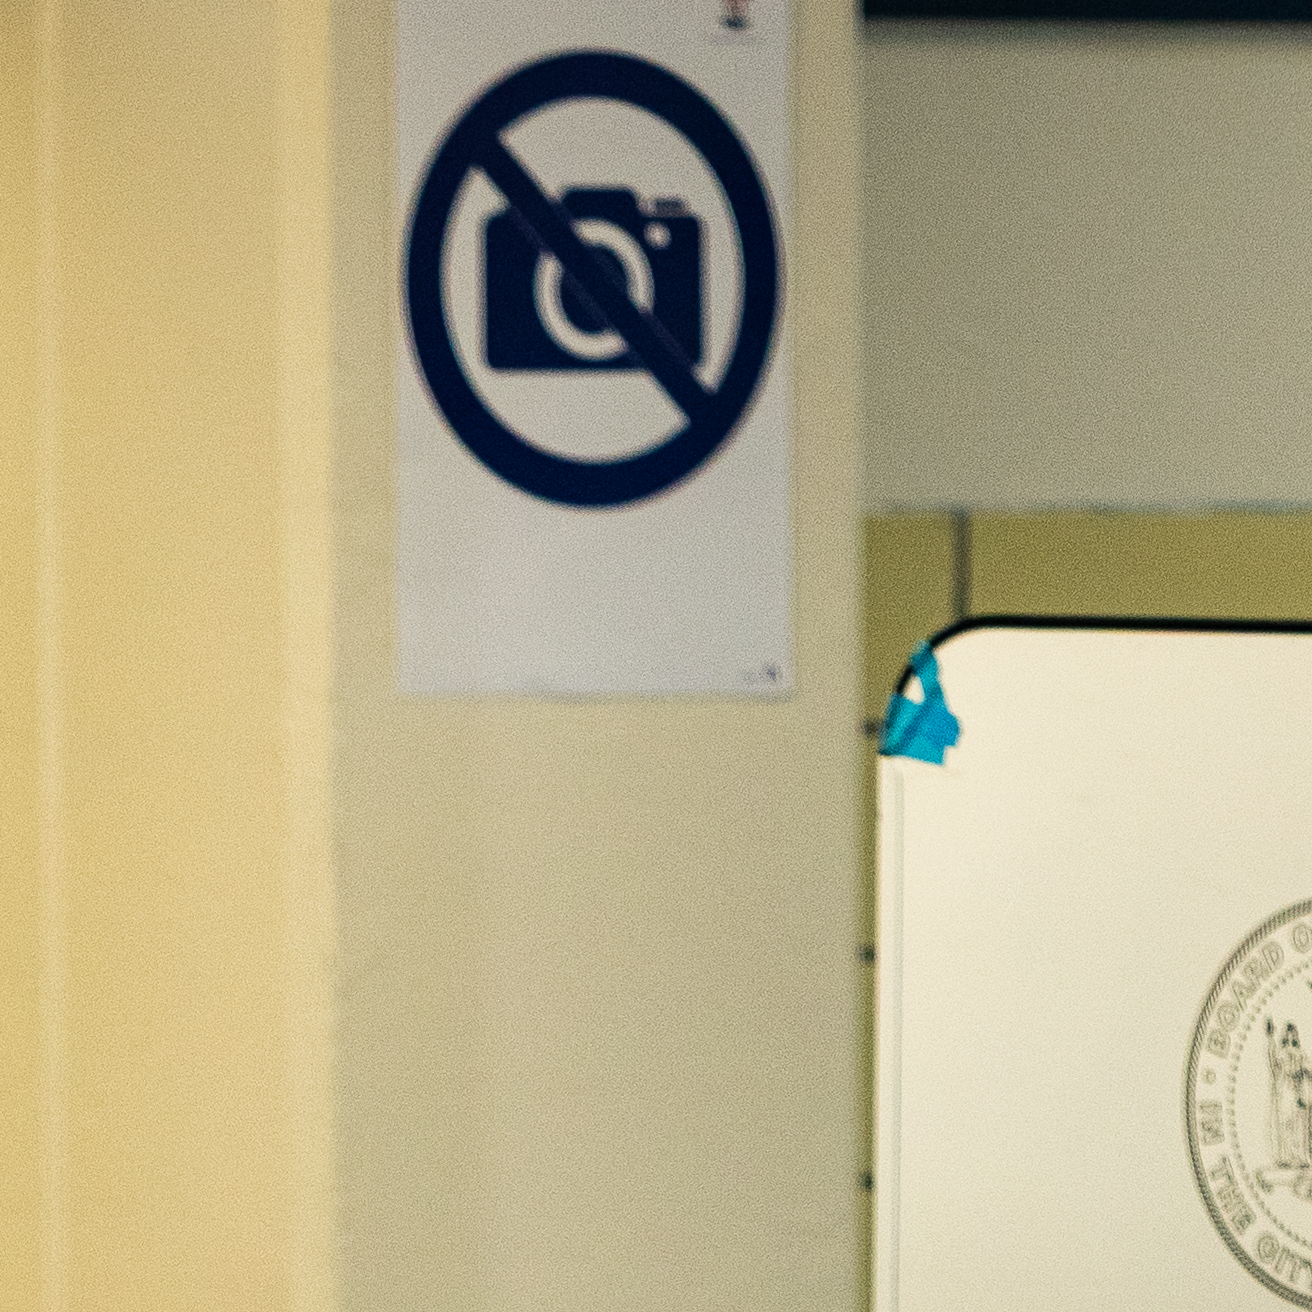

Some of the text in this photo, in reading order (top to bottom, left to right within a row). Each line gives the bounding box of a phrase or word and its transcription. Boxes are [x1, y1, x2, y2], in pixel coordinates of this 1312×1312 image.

[1207, 921, 1312, 1060] BOARD O
[1209, 1155, 1257, 1235] THE
[1257, 1233, 1312, 1288] CIT
